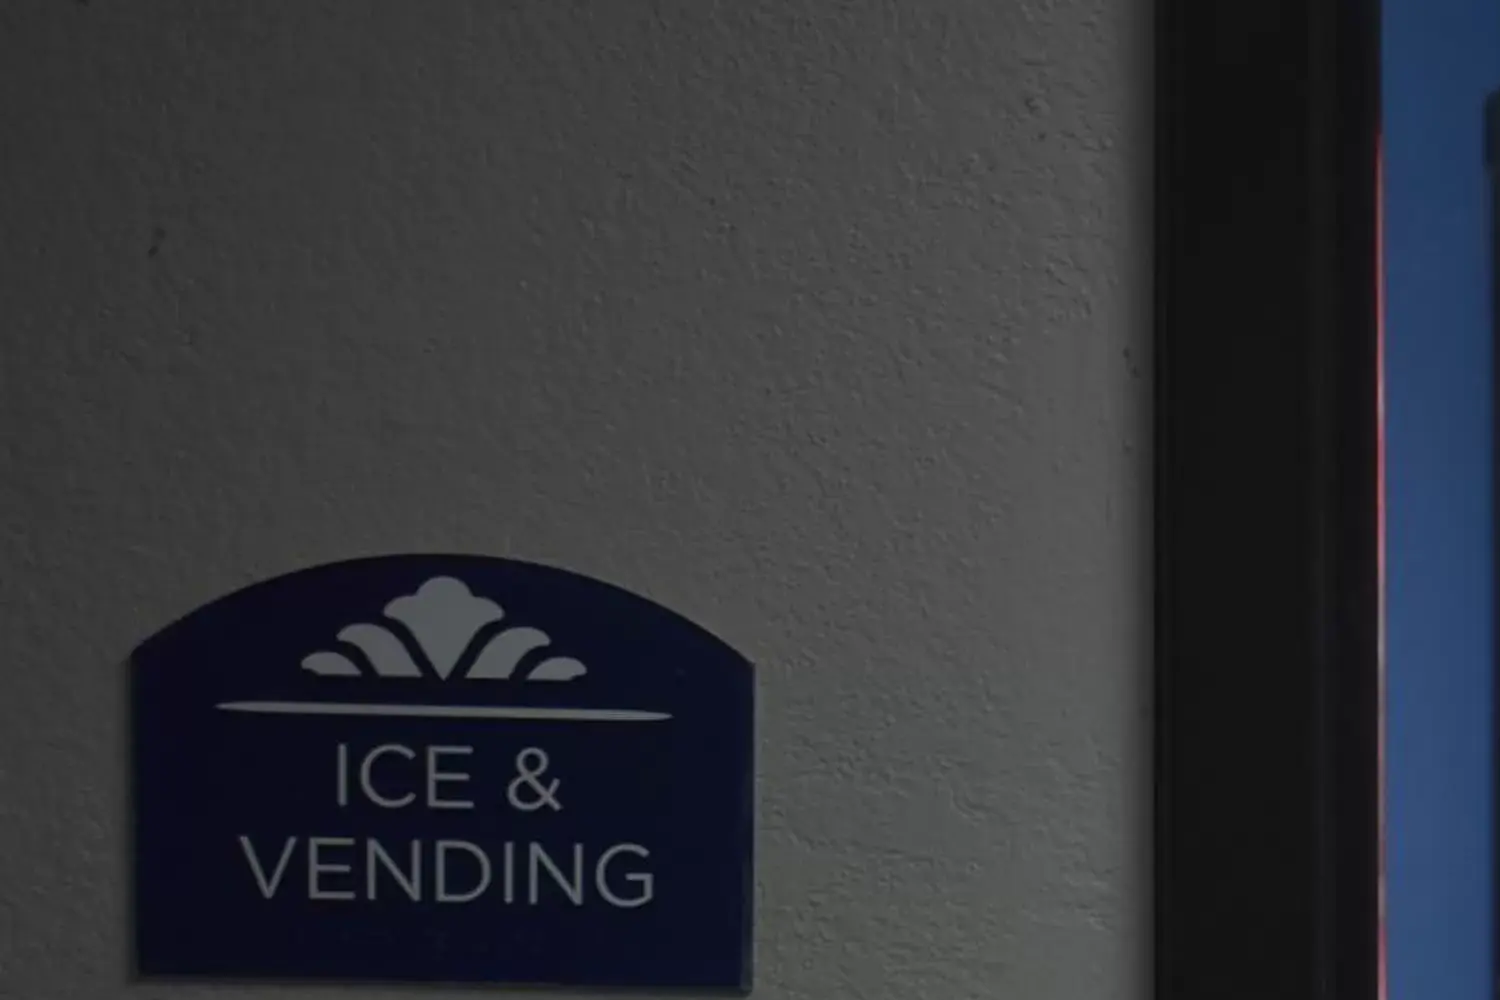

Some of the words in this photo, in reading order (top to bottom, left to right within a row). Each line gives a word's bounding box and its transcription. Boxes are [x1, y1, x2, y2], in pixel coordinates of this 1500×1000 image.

[336, 743, 475, 810] ICE
[506, 747, 563, 812] &
[237, 835, 656, 909] VENDING
